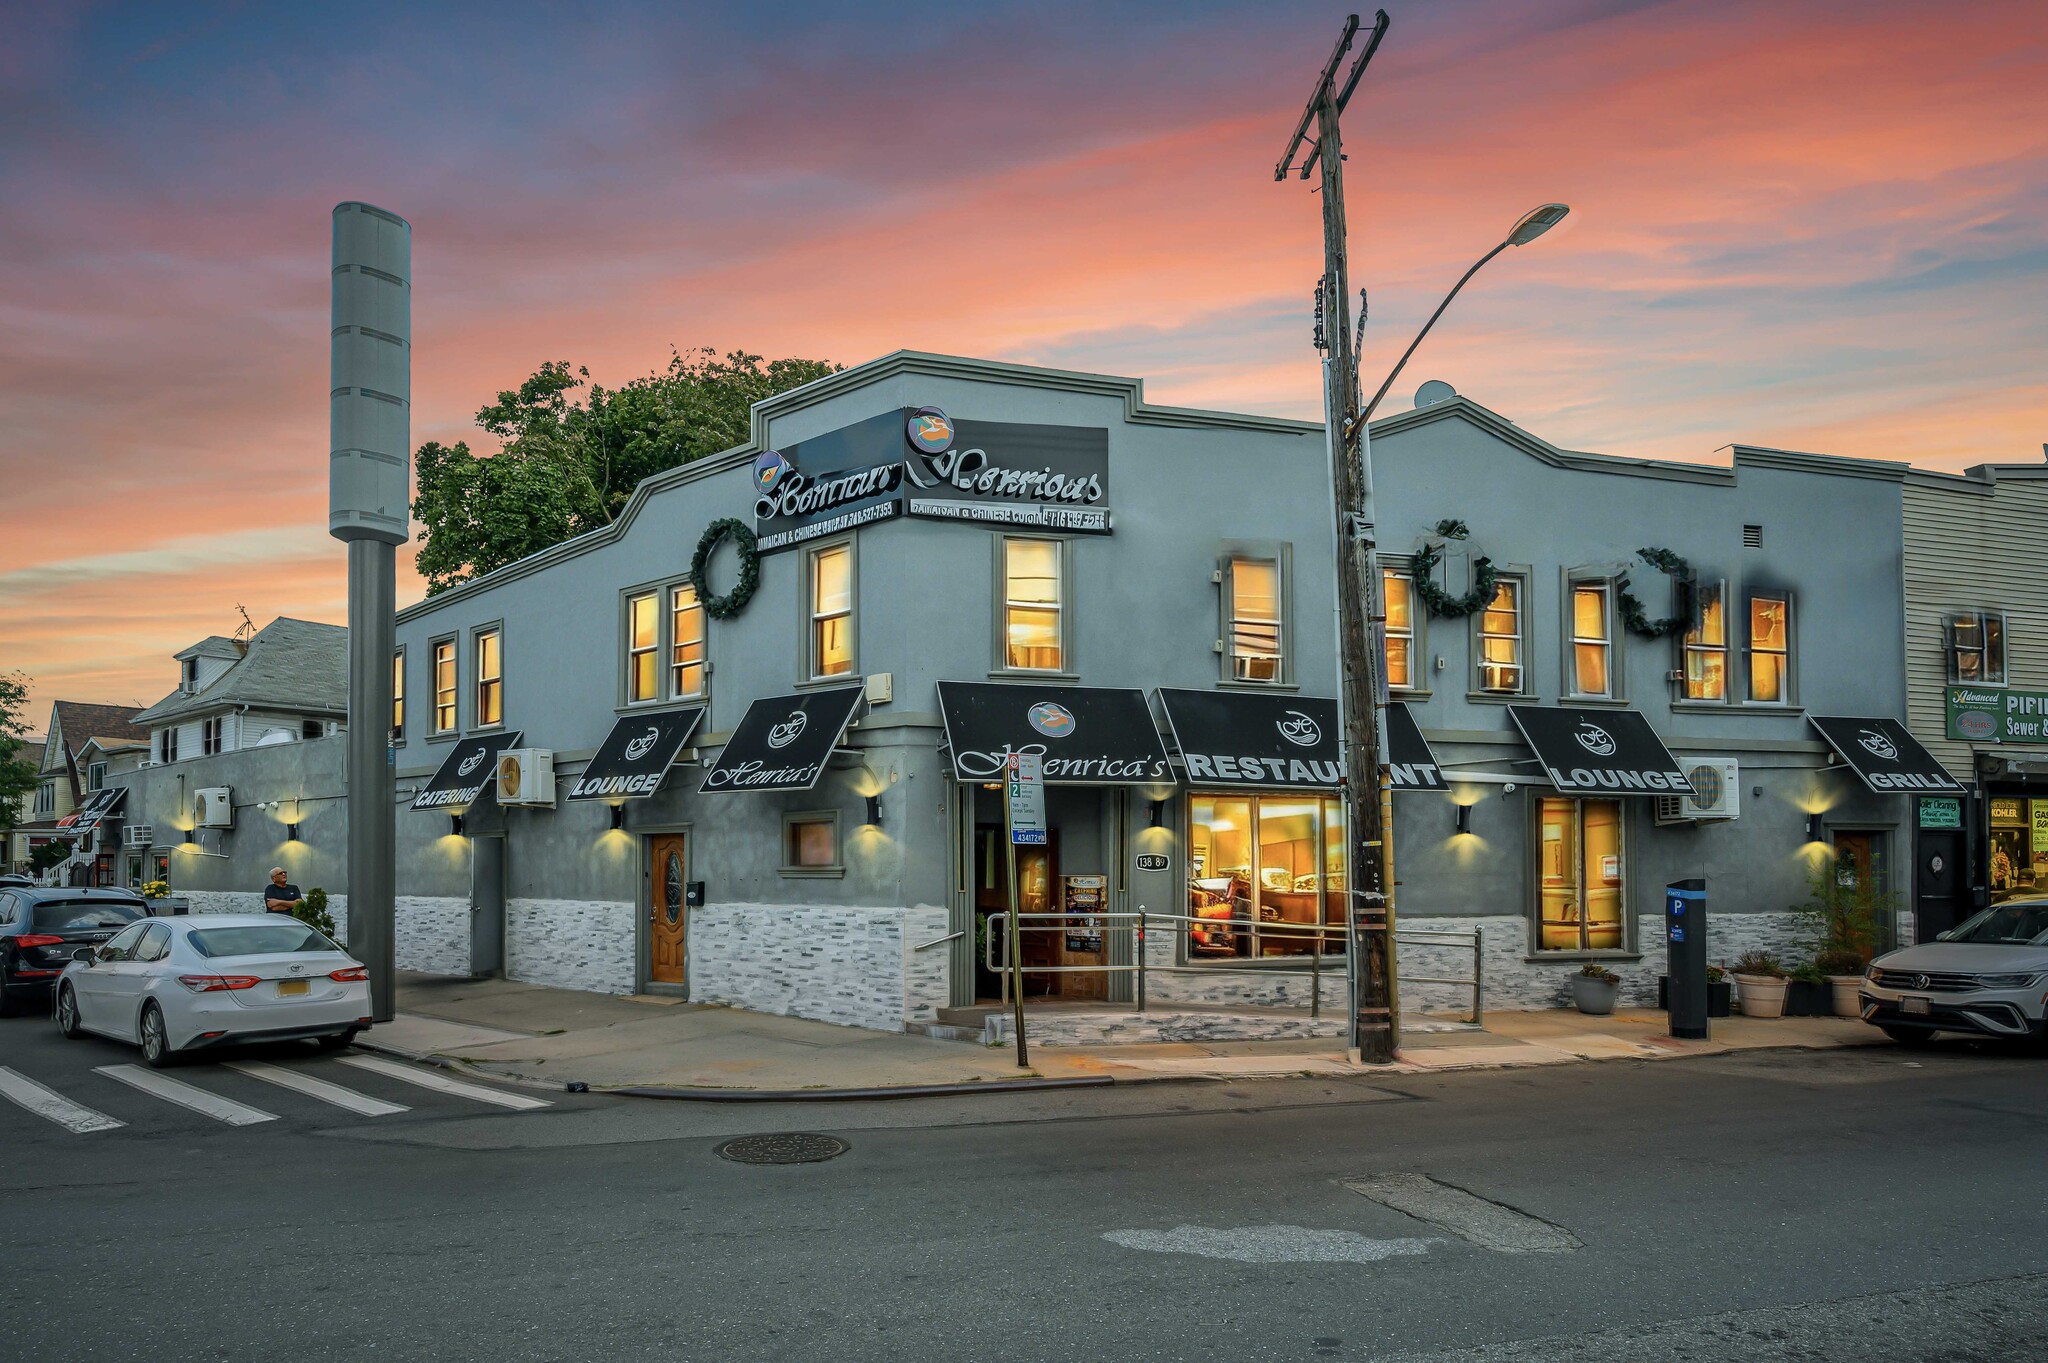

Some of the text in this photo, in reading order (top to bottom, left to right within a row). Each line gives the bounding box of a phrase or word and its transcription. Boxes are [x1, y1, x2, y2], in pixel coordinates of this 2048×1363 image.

[1953, 690, 1999, 703] Advanced
[1962, 720, 1992, 729] 24 HRS
[2006, 717, 2039, 736] Sewer
[957, 744, 1166, 778] Henrica's
[707, 760, 818, 787] Henrica's
[1188, 753, 1438, 787] RESTAUNT
[571, 772, 661, 796] LOUNGE
[1549, 768, 1691, 791] LOUNGE
[1867, 773, 1957, 788] GRILL
[415, 785, 480, 807] CATERING
[1012, 784, 1019, 797] 2
[1991, 808, 2018, 818] KOHLER
[1139, 857, 1165, 867] 138 89
[1674, 899, 1683, 914] P
